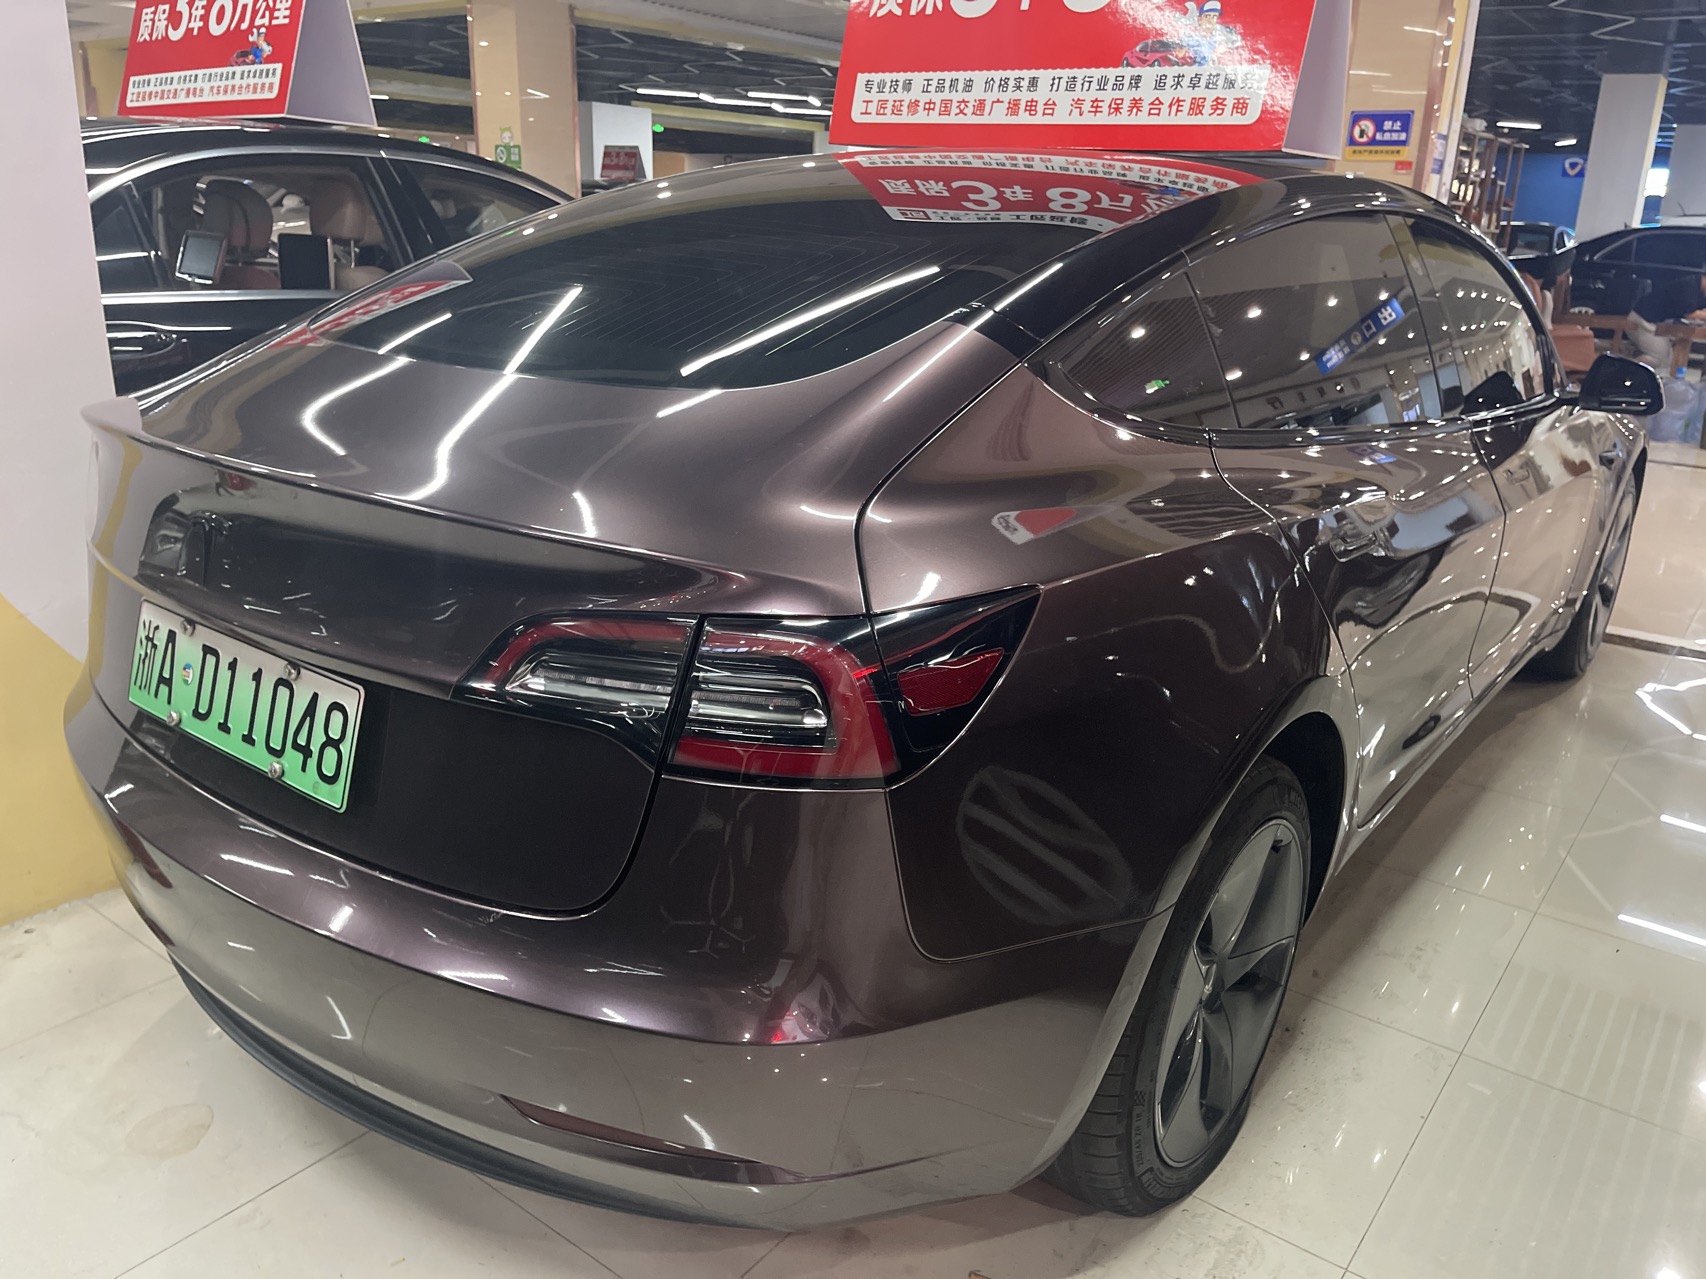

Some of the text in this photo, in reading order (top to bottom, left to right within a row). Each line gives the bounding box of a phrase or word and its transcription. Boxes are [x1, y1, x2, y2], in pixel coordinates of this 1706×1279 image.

[864, 78, 913, 94] 专业技师
[921, 77, 974, 93] 正品机油
[983, 76, 1040, 93] 价格实惠
[1049, 74, 1143, 92] 打造行业品牌
[859, 95, 1251, 117] 工匠延修中国交通广播电台 汽车保养合作服务商
